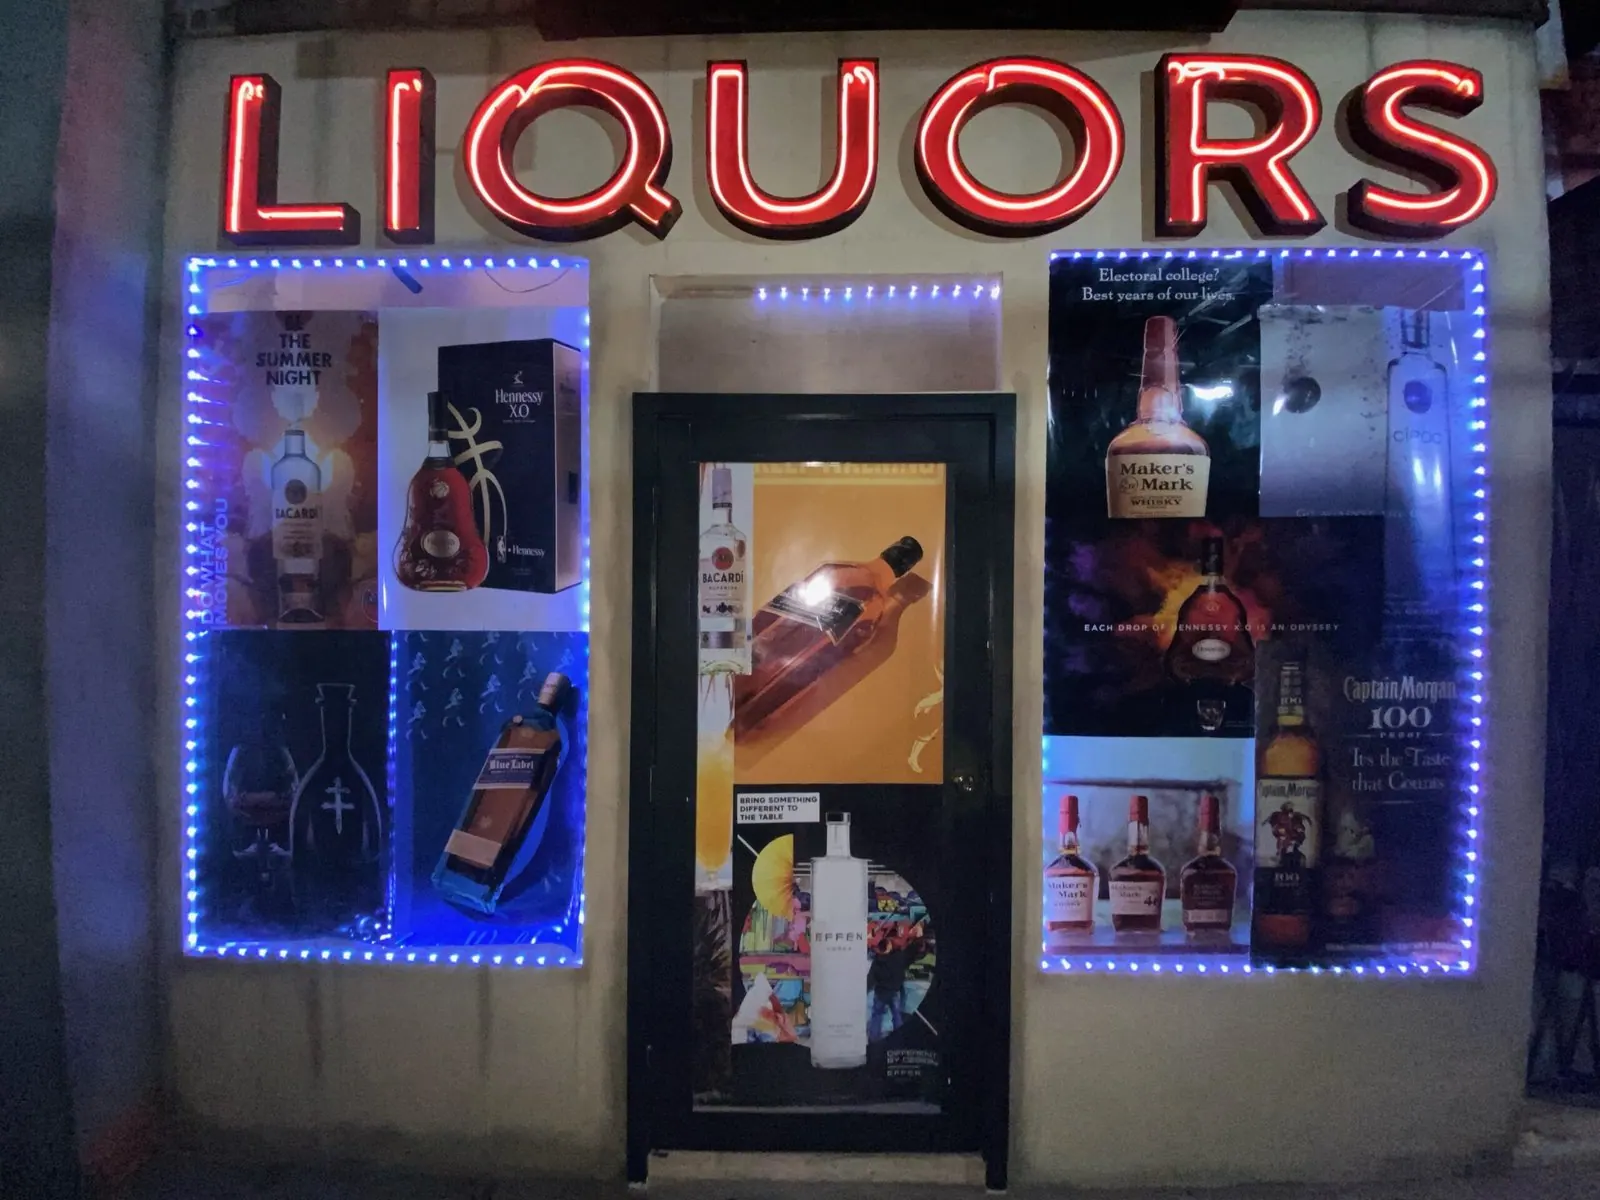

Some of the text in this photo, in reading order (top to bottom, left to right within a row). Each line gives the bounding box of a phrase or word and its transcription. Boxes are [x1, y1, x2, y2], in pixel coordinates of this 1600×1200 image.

[222, 52, 1499, 238] LIQUORS
[1099, 267, 1220, 283] Electoral college?
[1082, 286, 1113, 301] Best
[1117, 290, 1154, 302] years
[1157, 286, 1173, 300] of
[1174, 290, 1199, 301] our
[279, 333, 312, 349] THE
[256, 352, 332, 368] SUMMER
[266, 370, 322, 386] NIGHT
[495, 388, 543, 405] Hennessy
[1120, 462, 1195, 476] Maker's
[1140, 478, 1194, 490] Mark
[1084, 624, 1113, 632] EACH
[1118, 624, 1148, 632] DROP
[1343, 676, 1399, 703] Captain
[1368, 706, 1432, 729] 100
[511, 758, 534, 769] Label
[768, 796, 818, 804] SOMETHING
[815, 931, 863, 942] EFFEN
